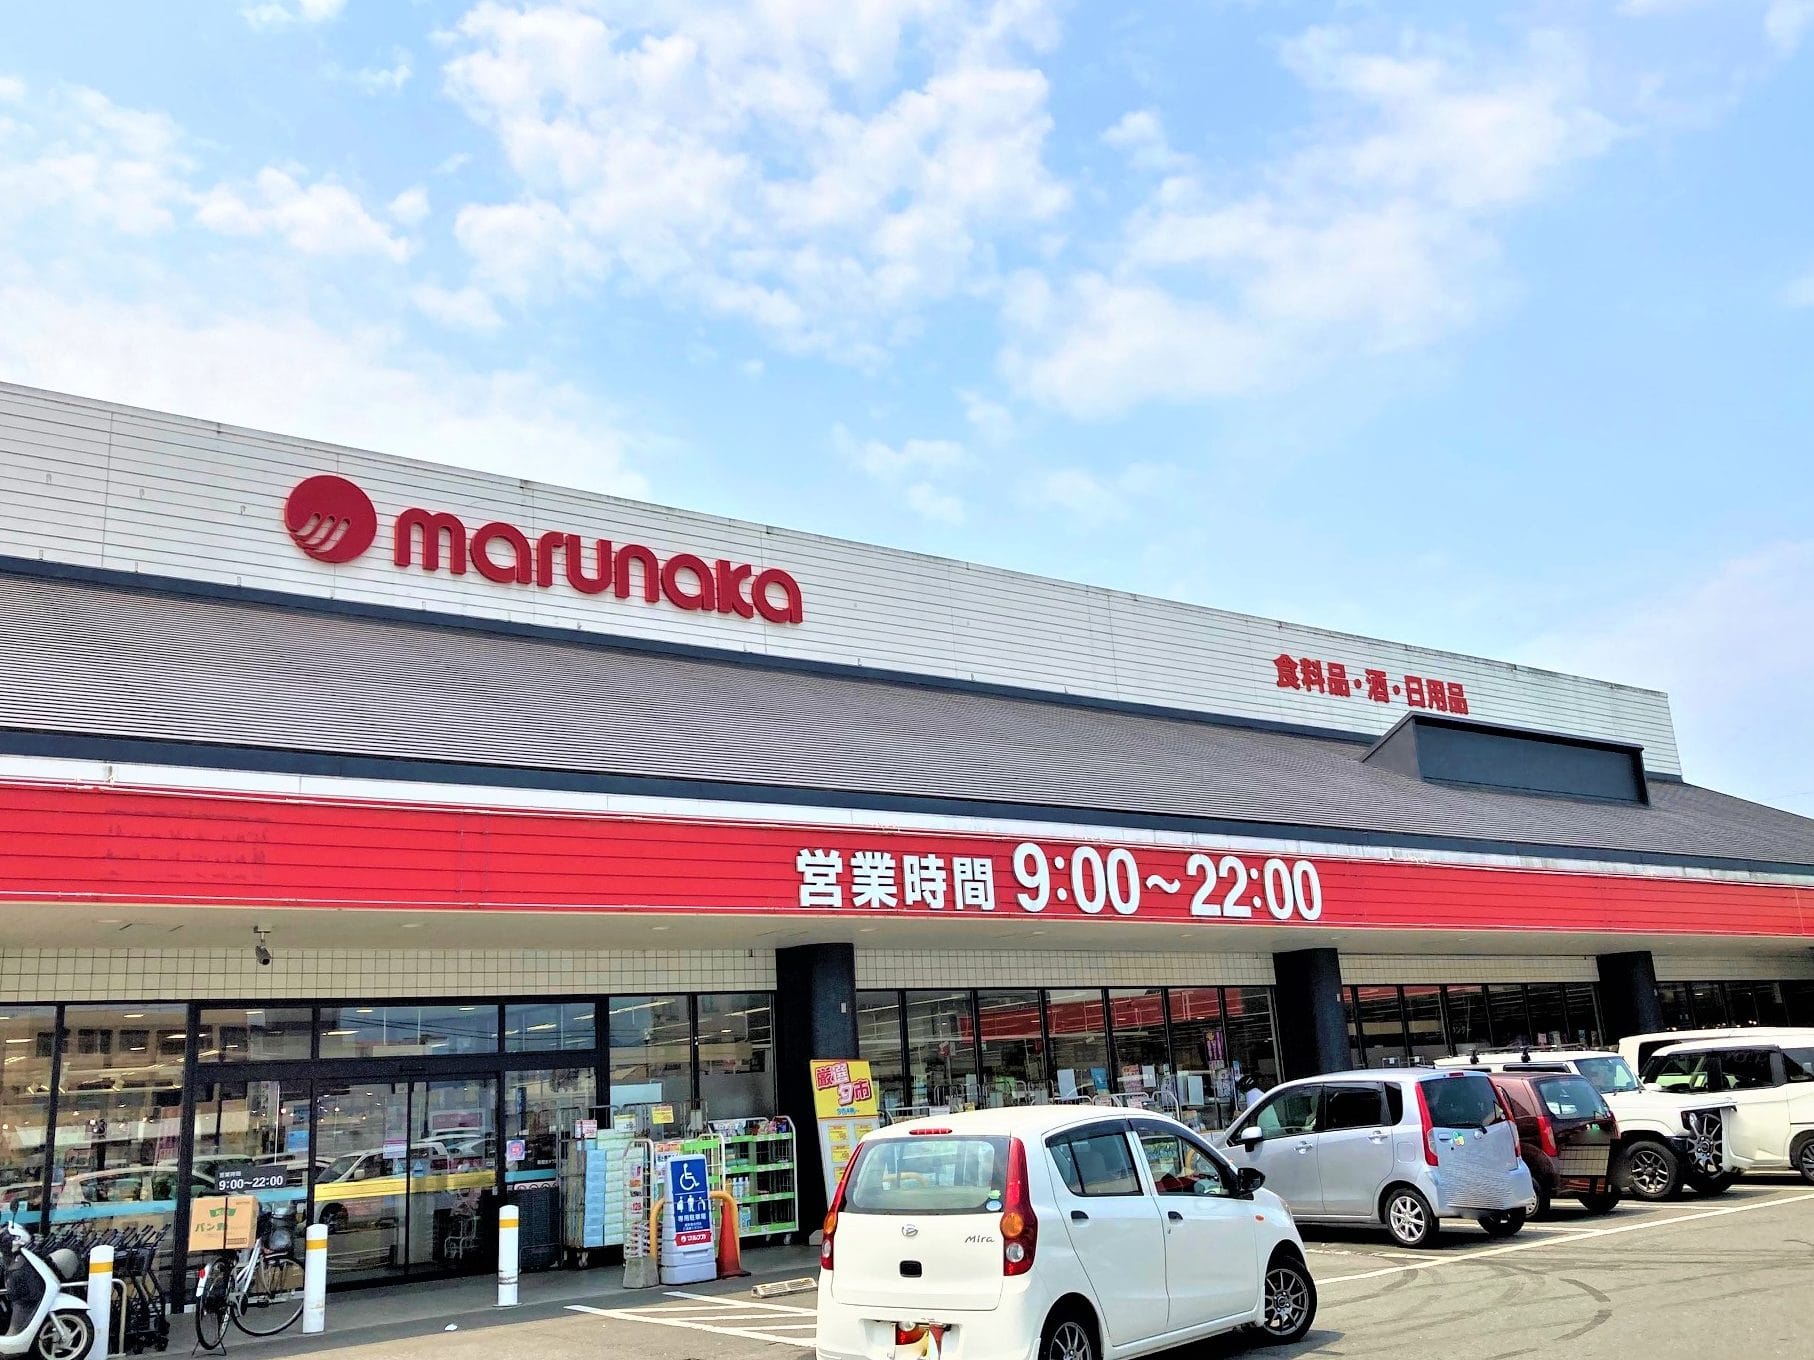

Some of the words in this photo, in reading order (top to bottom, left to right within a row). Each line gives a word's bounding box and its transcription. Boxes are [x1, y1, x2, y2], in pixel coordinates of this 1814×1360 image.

[394, 508, 804, 624] marunaka
[1273, 654, 1469, 715] 食料品・酒・日用品
[796, 848, 996, 911] 営業時間
[965, 1235, 995, 1243] Mira
